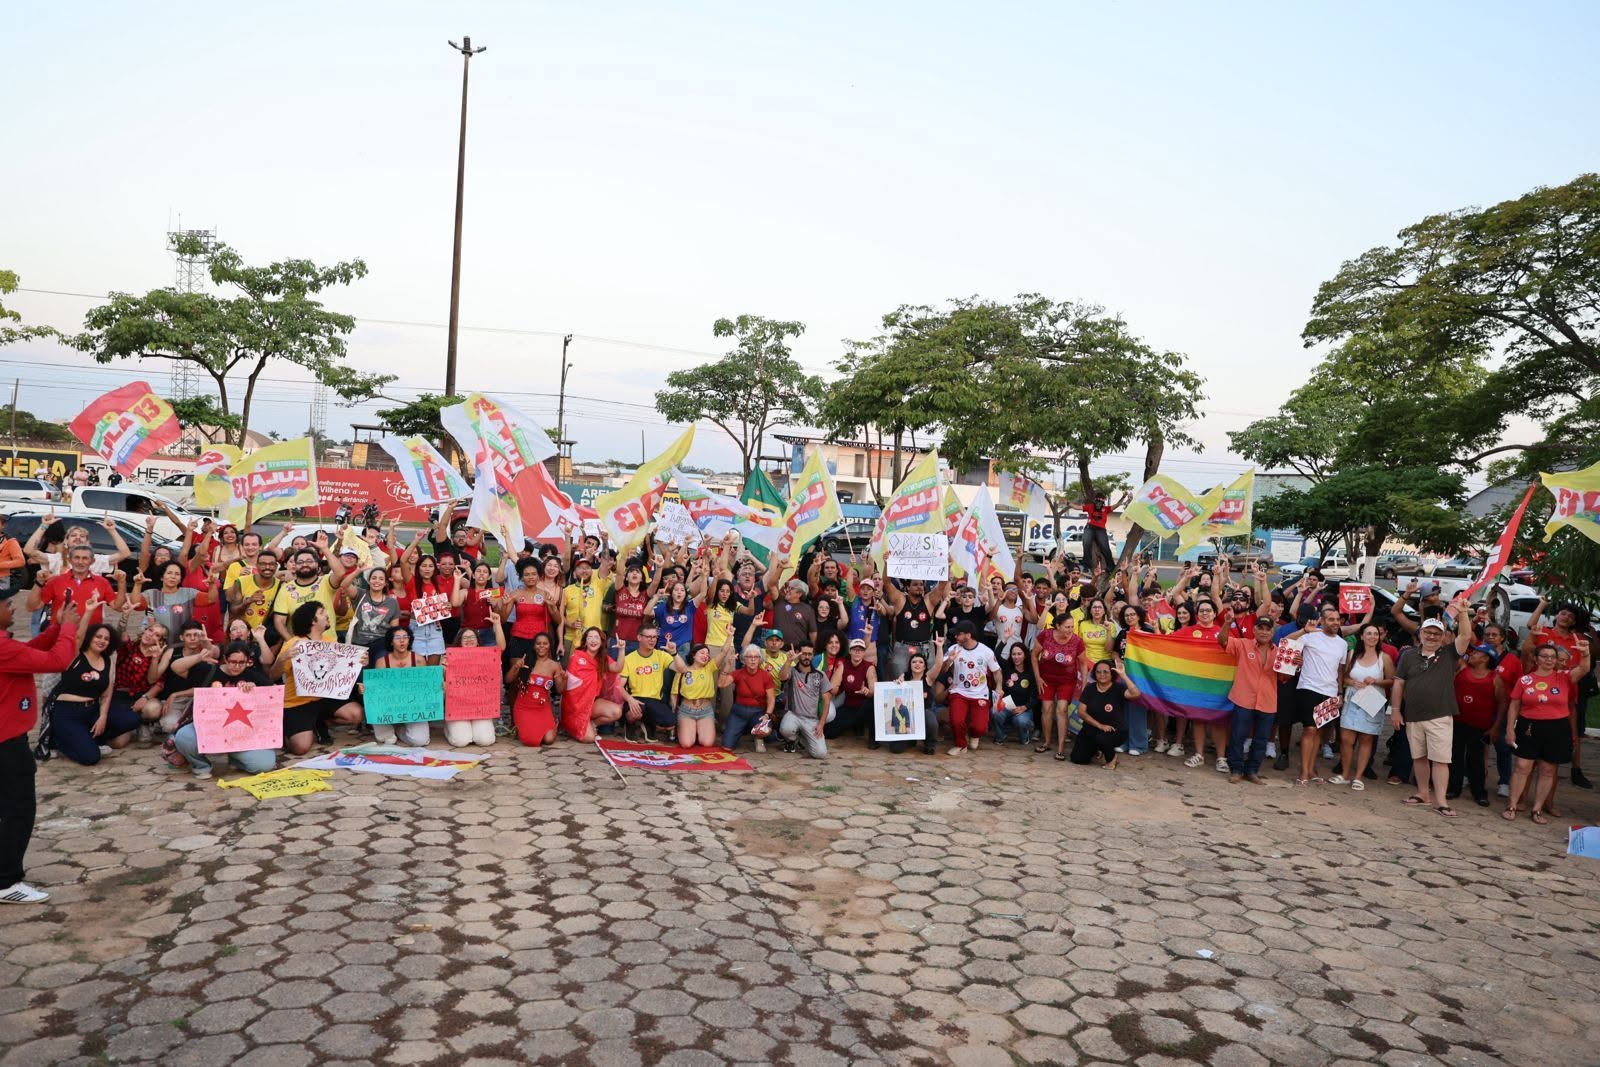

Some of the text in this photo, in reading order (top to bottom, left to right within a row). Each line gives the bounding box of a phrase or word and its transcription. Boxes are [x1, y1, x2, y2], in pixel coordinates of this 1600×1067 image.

[133, 398, 160, 423] 13
[556, 515, 578, 532] PT
[1347, 600, 1363, 611] 13
[397, 713, 408, 721] SE
